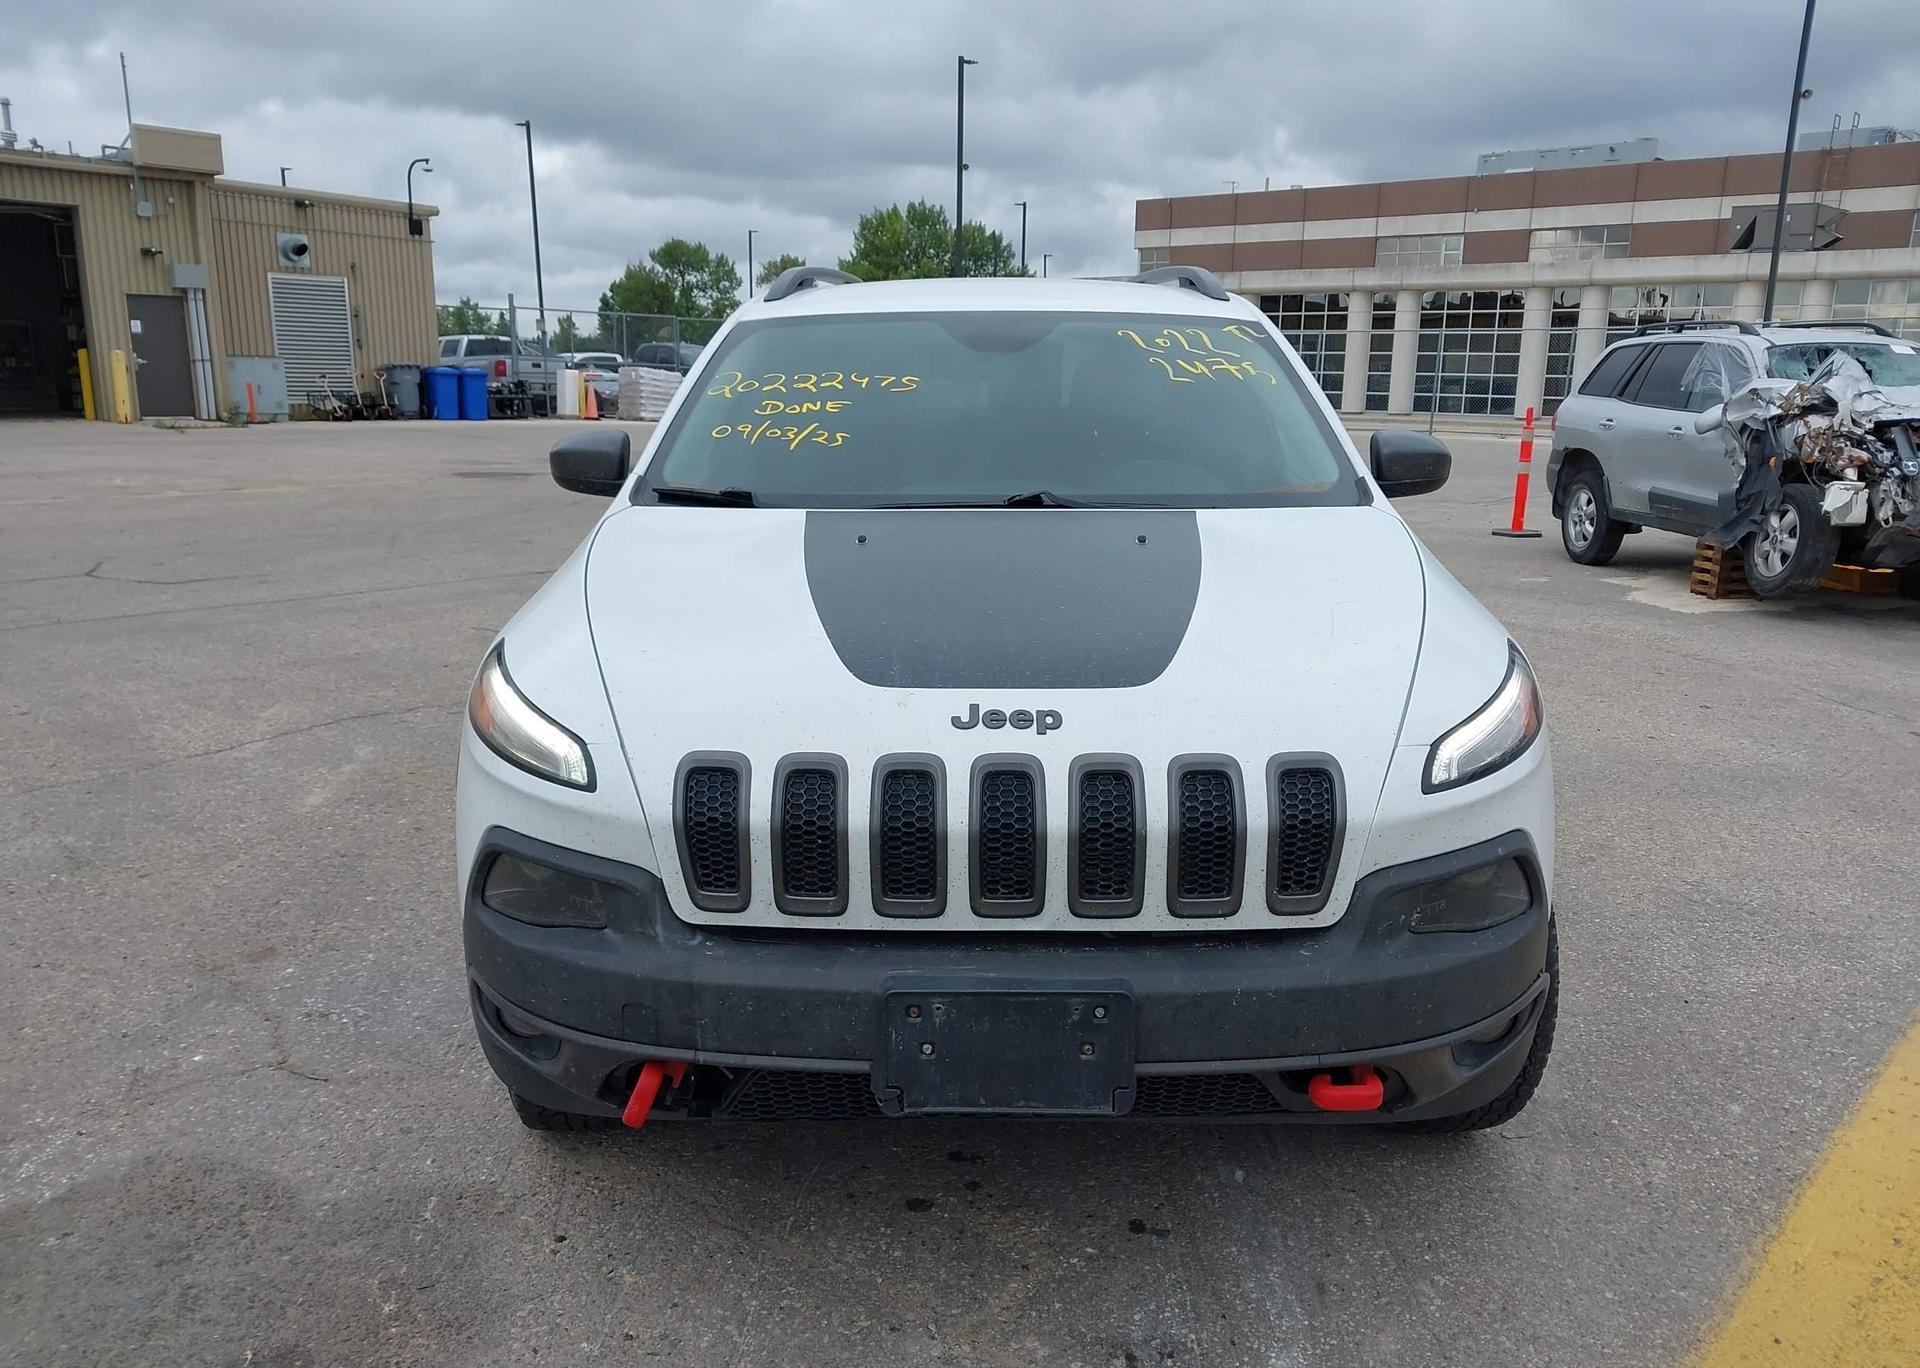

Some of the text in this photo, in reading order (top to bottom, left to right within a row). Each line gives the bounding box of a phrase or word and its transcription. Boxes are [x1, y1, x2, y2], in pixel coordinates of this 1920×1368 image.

[1117, 329, 1240, 357] 2022
[1149, 356, 1277, 384] 2475
[708, 371, 921, 398] 20222475
[754, 400, 852, 415] DONE
[711, 420, 851, 450] 09/03/25
[950, 703, 1063, 735] Jeep
